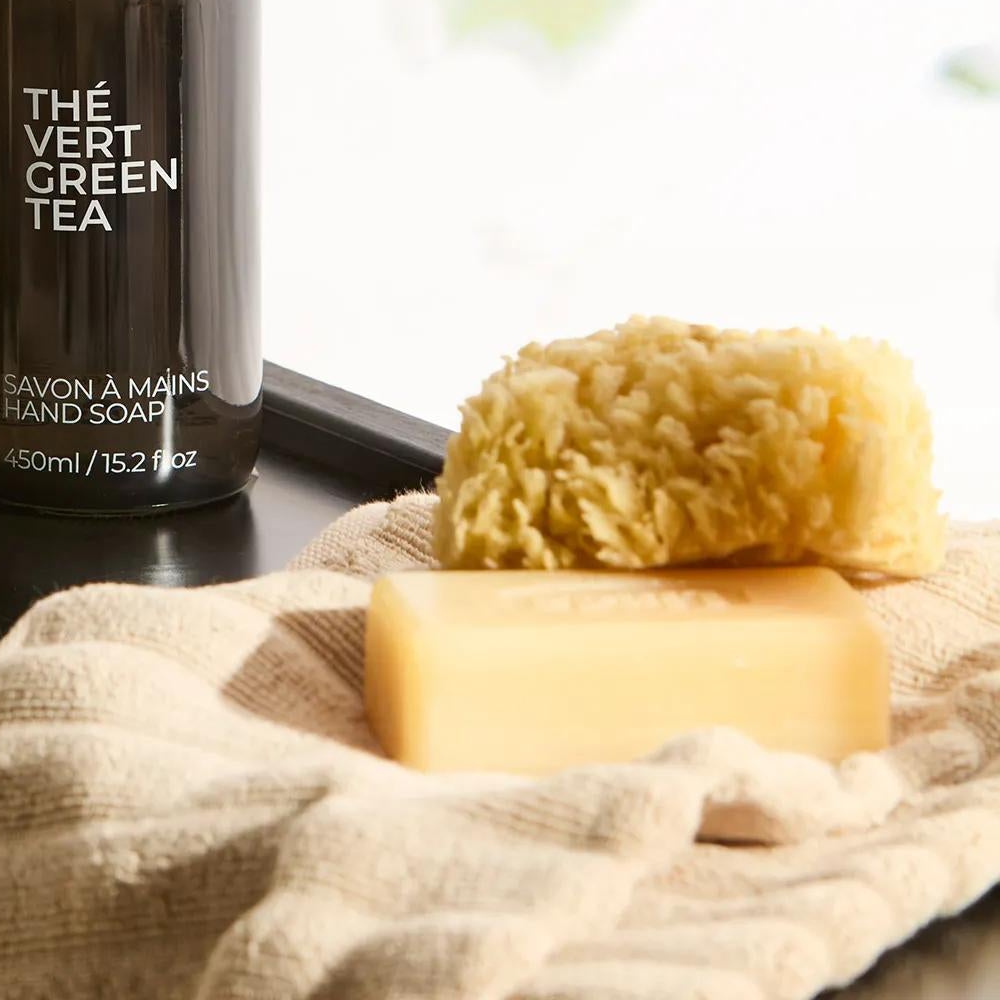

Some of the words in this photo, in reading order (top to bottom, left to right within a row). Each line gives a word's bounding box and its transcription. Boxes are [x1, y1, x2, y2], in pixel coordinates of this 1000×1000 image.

[23, 80, 112, 121] THÉ
[24, 124, 142, 158] VERT
[25, 157, 178, 195] GREEN
[24, 197, 113, 232] TEA
[3, 373, 93, 400] SAVON
[100, 373, 121, 400] À
[128, 370, 209, 399] MAINS
[4, 399, 82, 424] HAND
[89, 400, 165, 424] SOAP
[3, 448, 80, 474] 450ml
[85, 450, 98, 476] /
[101, 452, 146, 473] 15.2
